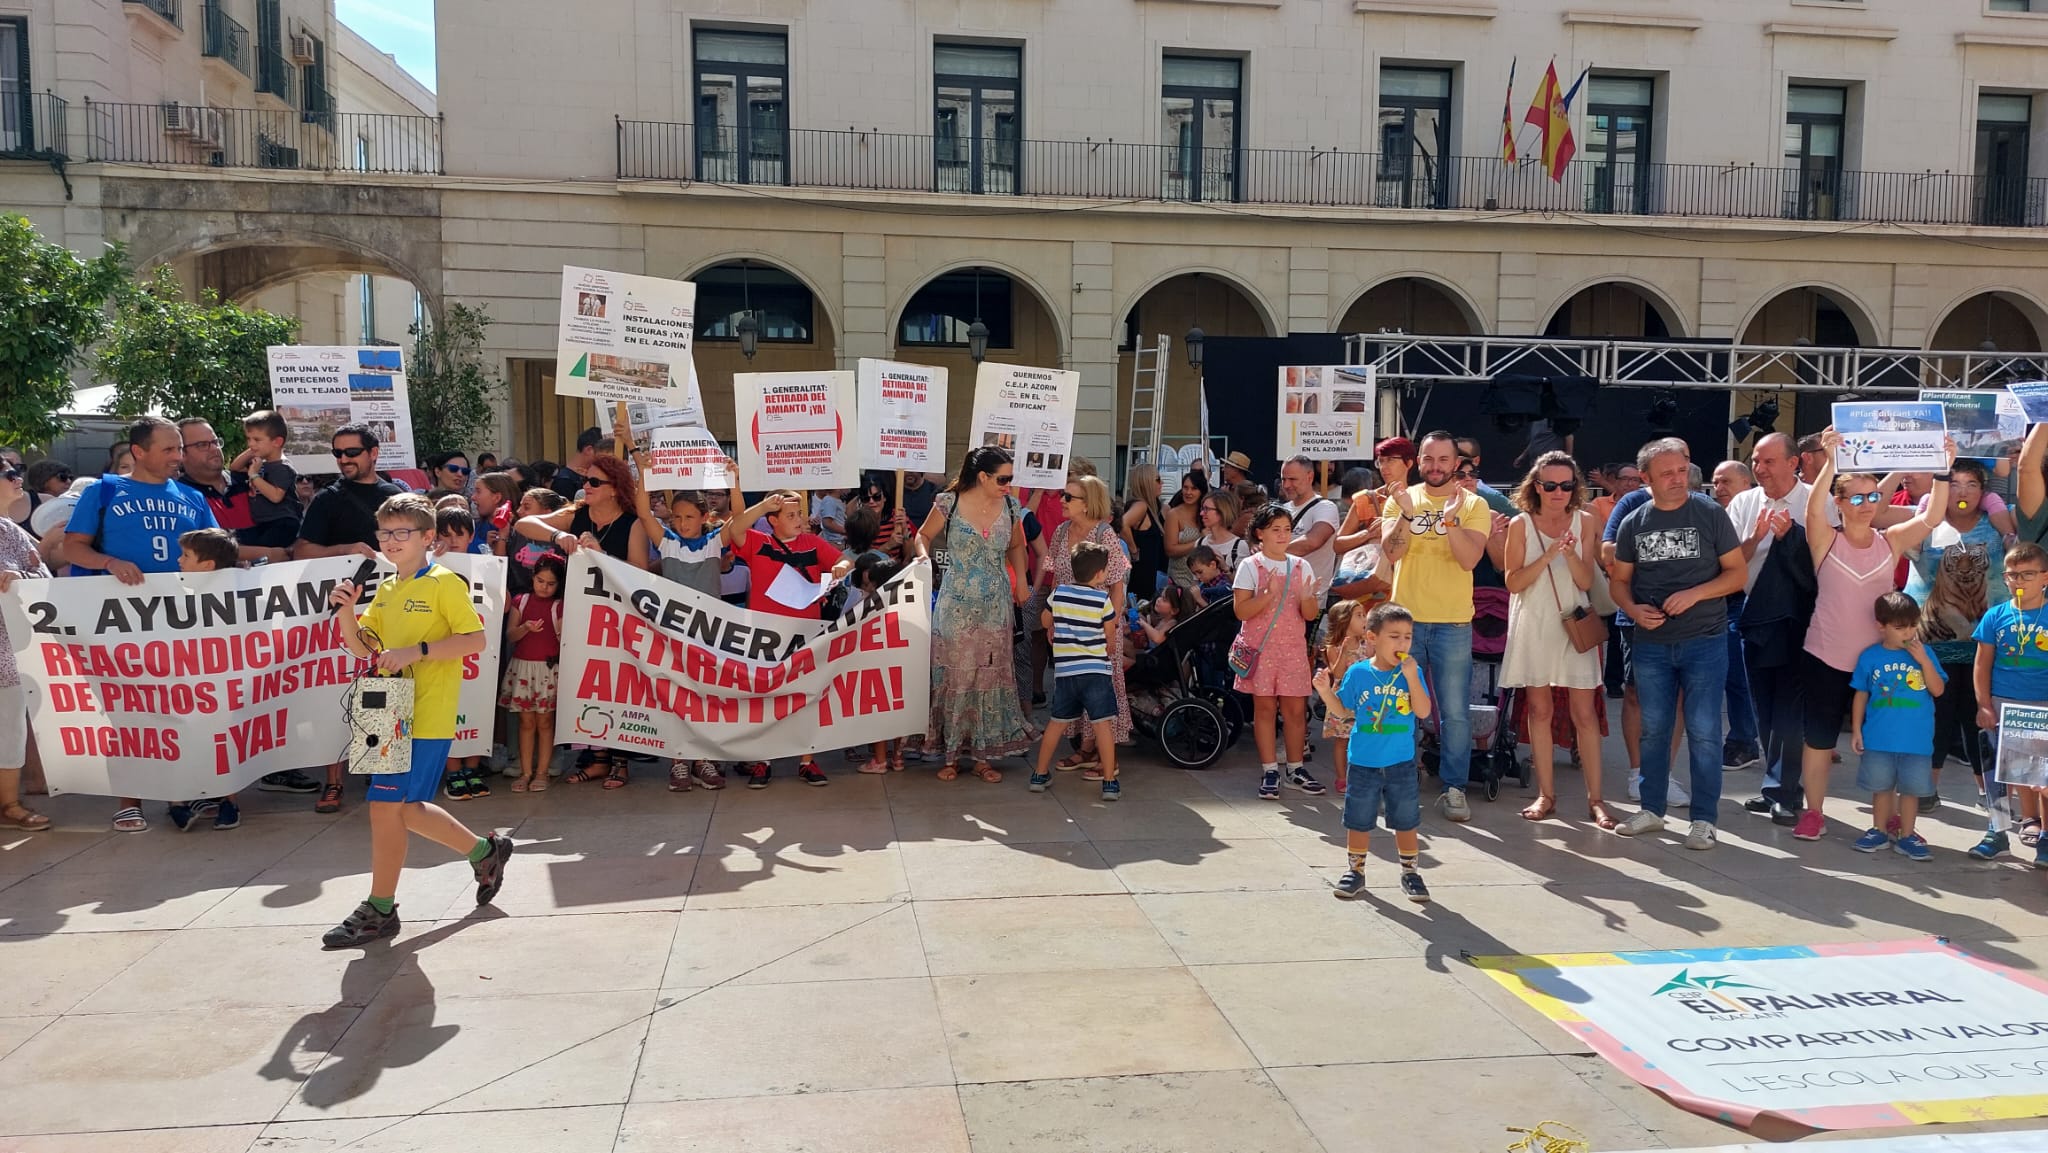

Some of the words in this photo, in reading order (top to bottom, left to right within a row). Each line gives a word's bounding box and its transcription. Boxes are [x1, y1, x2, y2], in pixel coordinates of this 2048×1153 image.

[622, 314, 694, 329] INSTALACIONES
[625, 325, 668, 337] SEGURAS
[670, 331, 684, 339] ¡YA
[624, 336, 637, 344] EN
[652, 340, 687, 350] AZORÍN
[888, 373, 929, 382] GENERALITAT:
[1013, 371, 1053, 381] QUEREMOS
[772, 384, 828, 394] GENERALITAT:
[882, 380, 915, 390] RETIRADA
[916, 382, 927, 391] DEL
[1005, 381, 1029, 389] C.E.I.P.
[587, 390, 624, 400] EMPECEMOS
[645, 396, 667, 404] TEJADO
[765, 393, 809, 404] RETIRADA
[810, 392, 827, 401] DEL
[882, 389, 914, 399] AMIANTO
[1020, 392, 1030, 400] EN
[1922, 392, 1972, 400] #PlanEdificant
[765, 404, 807, 414] AMIANTO
[809, 404, 826, 416] ¡YA!
[1009, 402, 1047, 411] EDIFICANT
[774, 442, 831, 450] AYUNTAMIENTO:
[677, 466, 692, 477] ¡YA!
[112, 498, 197, 521] OKLAHOMA
[143, 515, 177, 531] CITY
[152, 535, 169, 562] 9
[28, 601, 77, 636] 2.
[583, 566, 622, 603] 1.
[630, 577, 915, 662] GENERAAT:
[586, 603, 817, 694] RETIRADA
[827, 611, 909, 663] DEL
[48, 682, 97, 713] DE
[99, 681, 219, 716] PATIOS
[226, 678, 245, 712] E
[576, 658, 807, 724] AMIANTO
[818, 665, 905, 728] ¡YA!
[620, 709, 650, 723] AMPA
[618, 721, 658, 736] AZORIN
[59, 725, 181, 762] DIGNAS
[213, 707, 289, 776] ¡YA!
[617, 733, 665, 750] ALICANTE
[1667, 991, 1704, 1000] CEIP
[1678, 999, 1738, 1015] EL
[1736, 989, 1964, 1013] PALMERAL
[1708, 1011, 1790, 1022] ALACANT
[1666, 1027, 1929, 1053] COMPARTIM
[1721, 1069, 1924, 1094] L'ESCOLA
[1923, 1063, 2014, 1081] QUE
